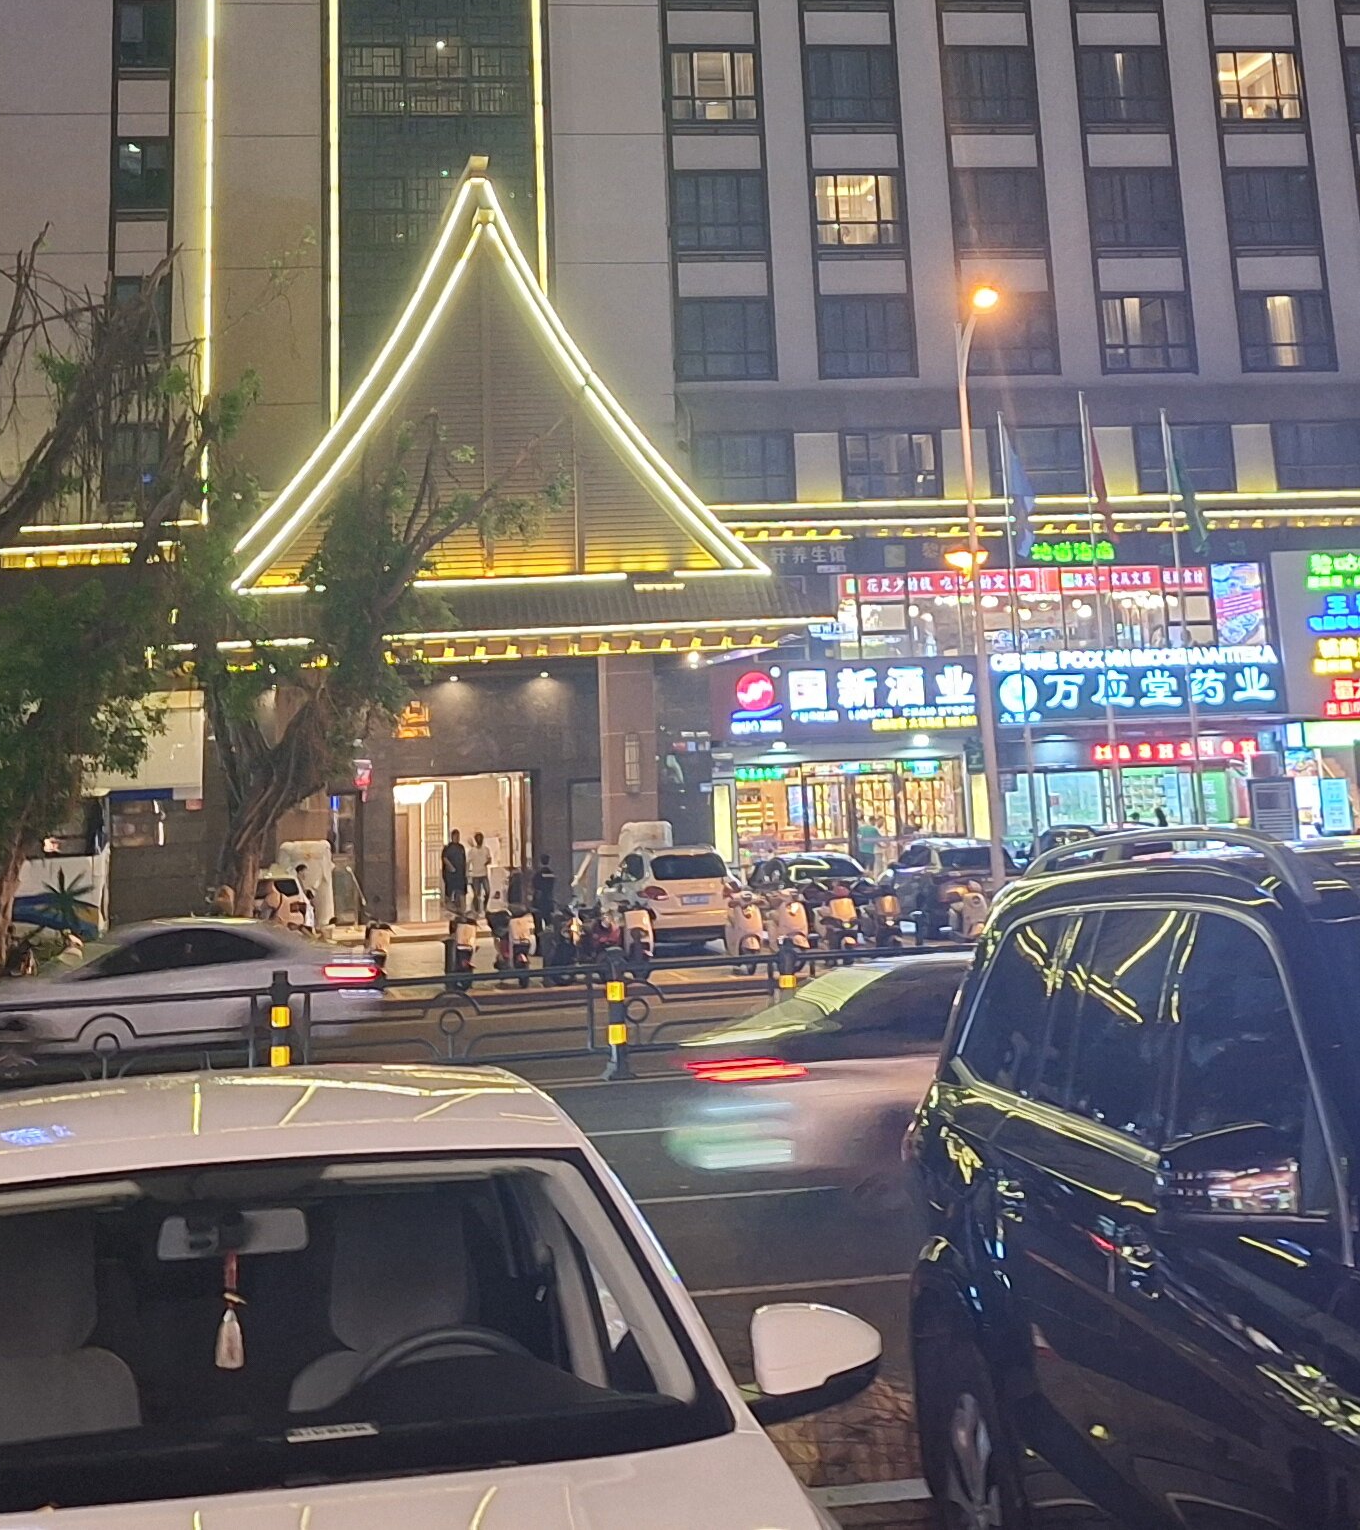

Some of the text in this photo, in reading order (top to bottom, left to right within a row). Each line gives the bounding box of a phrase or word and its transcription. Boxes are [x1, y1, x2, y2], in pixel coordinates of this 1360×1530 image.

[1043, 666, 1277, 709] 万应堂药业
